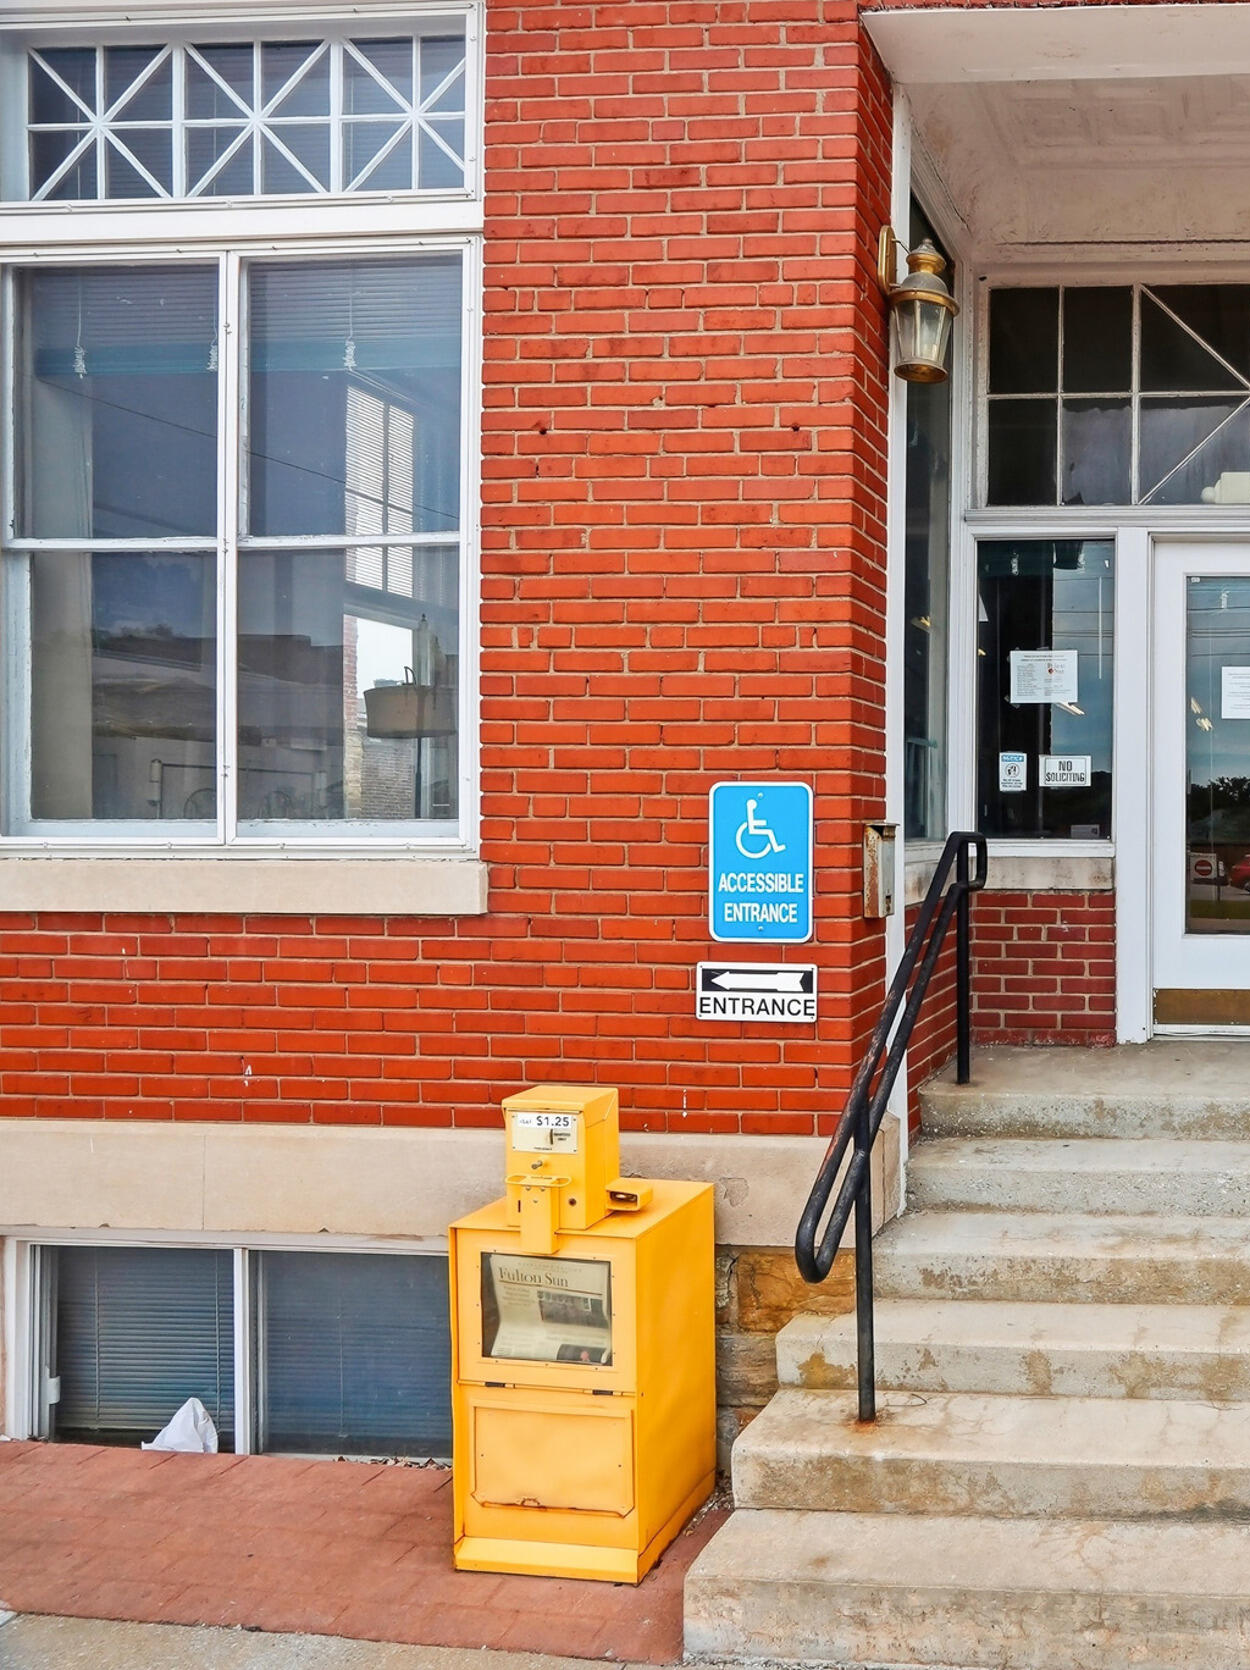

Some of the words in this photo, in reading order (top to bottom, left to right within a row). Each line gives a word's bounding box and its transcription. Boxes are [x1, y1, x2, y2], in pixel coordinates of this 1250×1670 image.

[1045, 771, 1085, 782] SOLICITING
[1058, 760, 1073, 772] NO
[718, 872, 804, 893] ACCESSIBLE
[724, 902, 798, 923] ENTRANCE
[699, 996, 815, 1017] ENTRANCE
[536, 1115, 570, 1127] $1.25
[498, 1266, 542, 1284] Fulton
[545, 1272, 569, 1288] Sun
